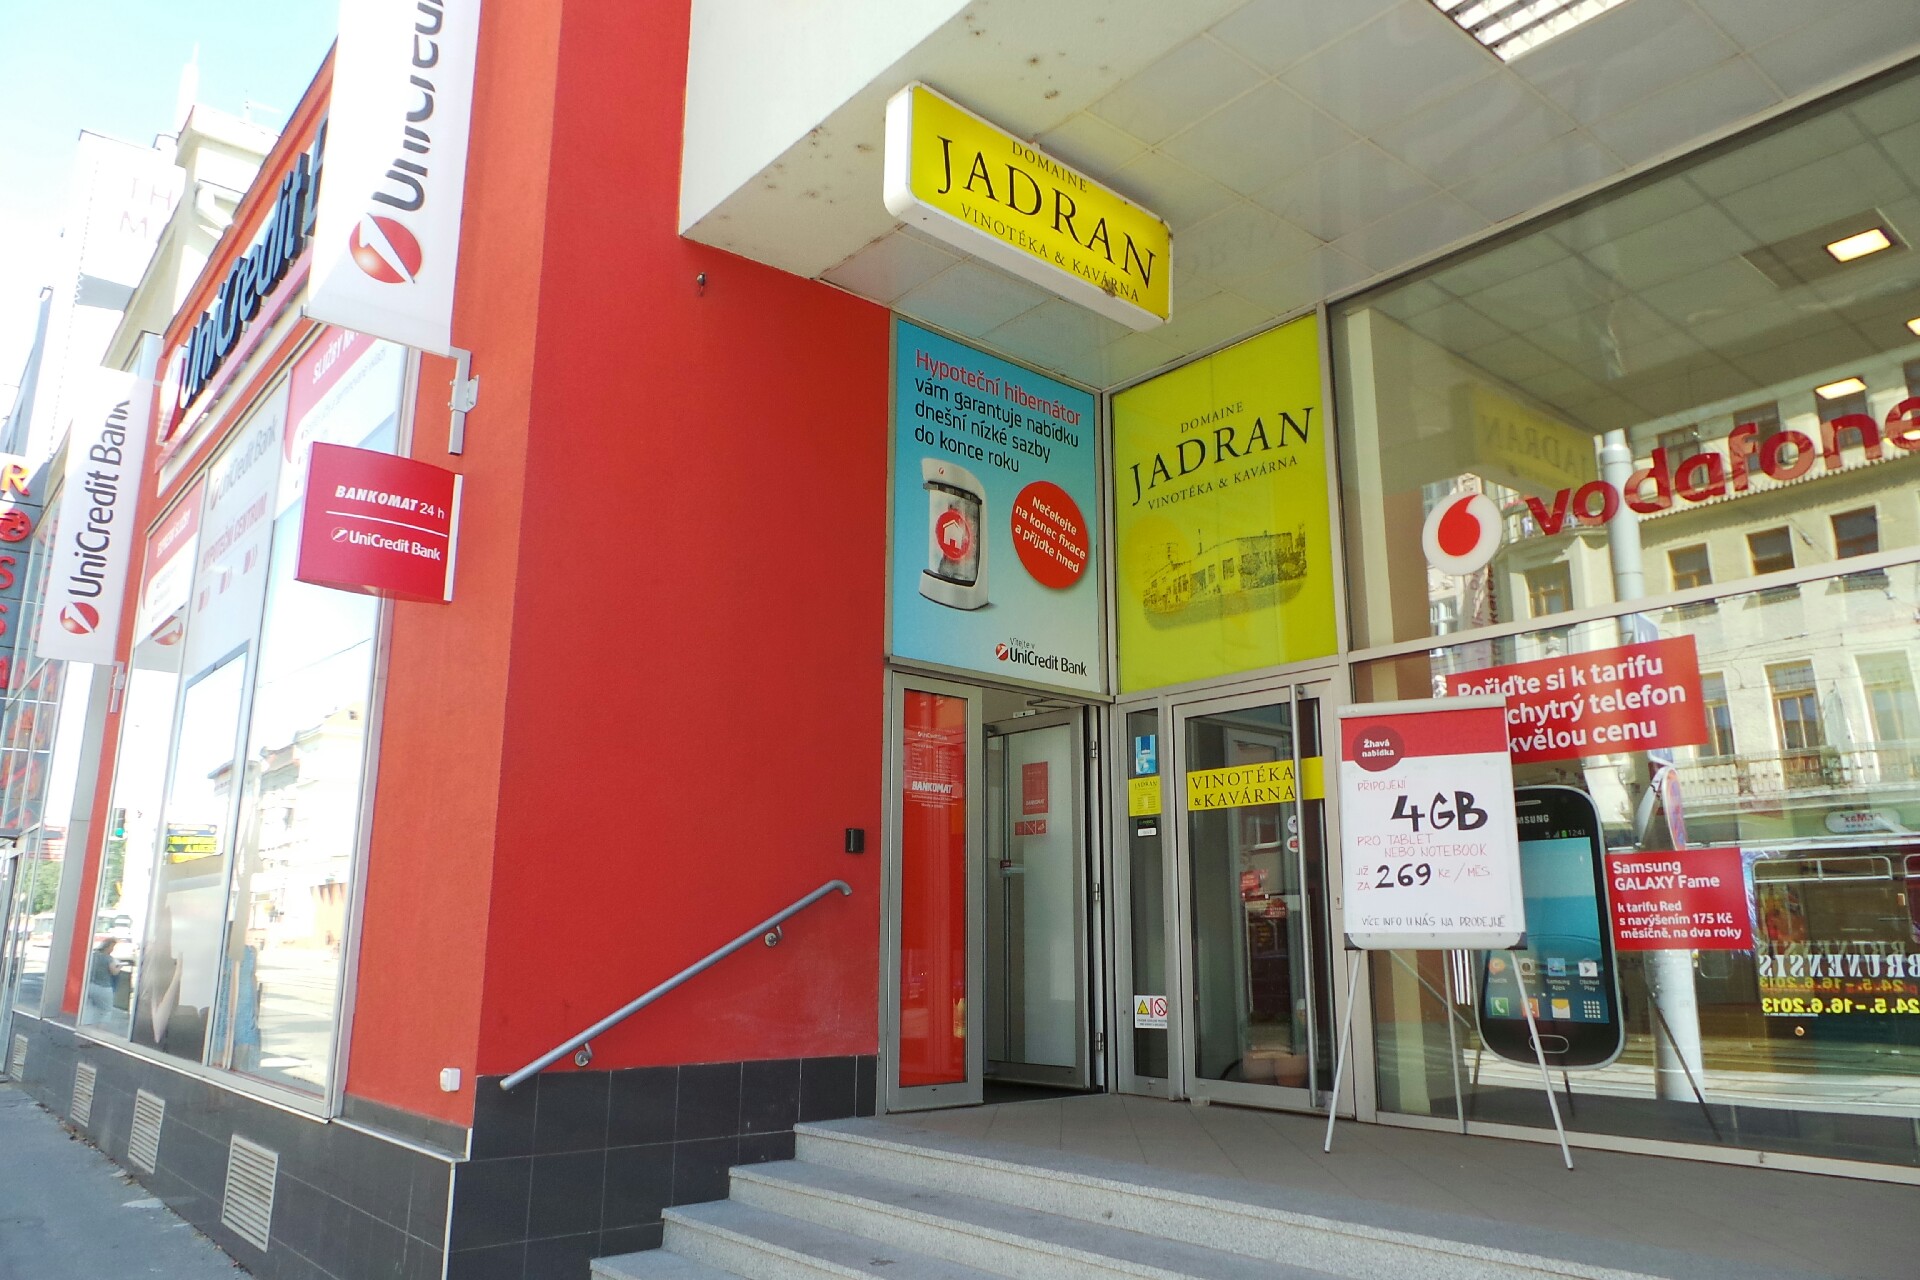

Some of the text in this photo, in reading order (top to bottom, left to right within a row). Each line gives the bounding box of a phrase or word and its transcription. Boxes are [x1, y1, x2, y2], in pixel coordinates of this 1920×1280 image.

[1012, 142, 1087, 193] DOMAINE
[937, 135, 1156, 289] JADRAN
[961, 203, 1139, 303] VINOTÉKA & KAVÁRNA
[180, 152, 310, 409] UniCredit
[915, 348, 1081, 425] Hypoteční hibernátor
[915, 377, 1079, 448] vám garantuje nabídku
[1180, 401, 1244, 434] DOMAINE
[915, 400, 1051, 464] dnešní nízké sazby
[915, 425, 1019, 473] do konce roku
[1130, 406, 1314, 506] JADRAN
[1525, 395, 1920, 536] vodafone
[1148, 455, 1298, 510] VINOTÉKA & KAVÁRNA
[334, 485, 445, 519] BANKOMAT 24 h
[1032, 496, 1077, 536] Nečekejte
[67, 470, 119, 598] UniCredit
[348, 530, 441, 561] UniCredit Bank
[1015, 506, 1086, 560] na konec fixace
[1015, 525, 1079, 574] a přijďte hned
[1010, 647, 1088, 677] UniCredit Bank
[1546, 668, 1566, 691] si
[1570, 665, 1586, 687] k
[1590, 654, 1663, 684] tarifu
[1507, 683, 1686, 727] chytrý telefon
[1363, 738, 1390, 749] Žhavá
[1592, 719, 1657, 744] cenu
[1362, 749, 1395, 758] nabídka
[911, 780, 954, 794] BANKOMAT
[1192, 765, 1294, 790] VINOTÉKA
[1357, 776, 1407, 791] PŘIPOJENÍ
[1357, 833, 1433, 847] PRO TABLET
[1384, 843, 1487, 858] NEBO NOTEBOOK
[1374, 862, 1432, 888] 269
[1612, 861, 1682, 875] Samsung
[1614, 874, 1720, 891] GALAXY Fame
[1357, 881, 1371, 891] ZA
[1362, 915, 1379, 926] VÍCE
[1382, 917, 1402, 926] INFO
[1441, 917, 1453, 927] NA
[1459, 914, 1506, 928] PRODEJNĚ
[1617, 901, 1682, 913] k tarifu Red
[1619, 912, 1733, 927] s navýšením 175 Kč
[1620, 926, 1742, 939] měsíčně, na dva roky
